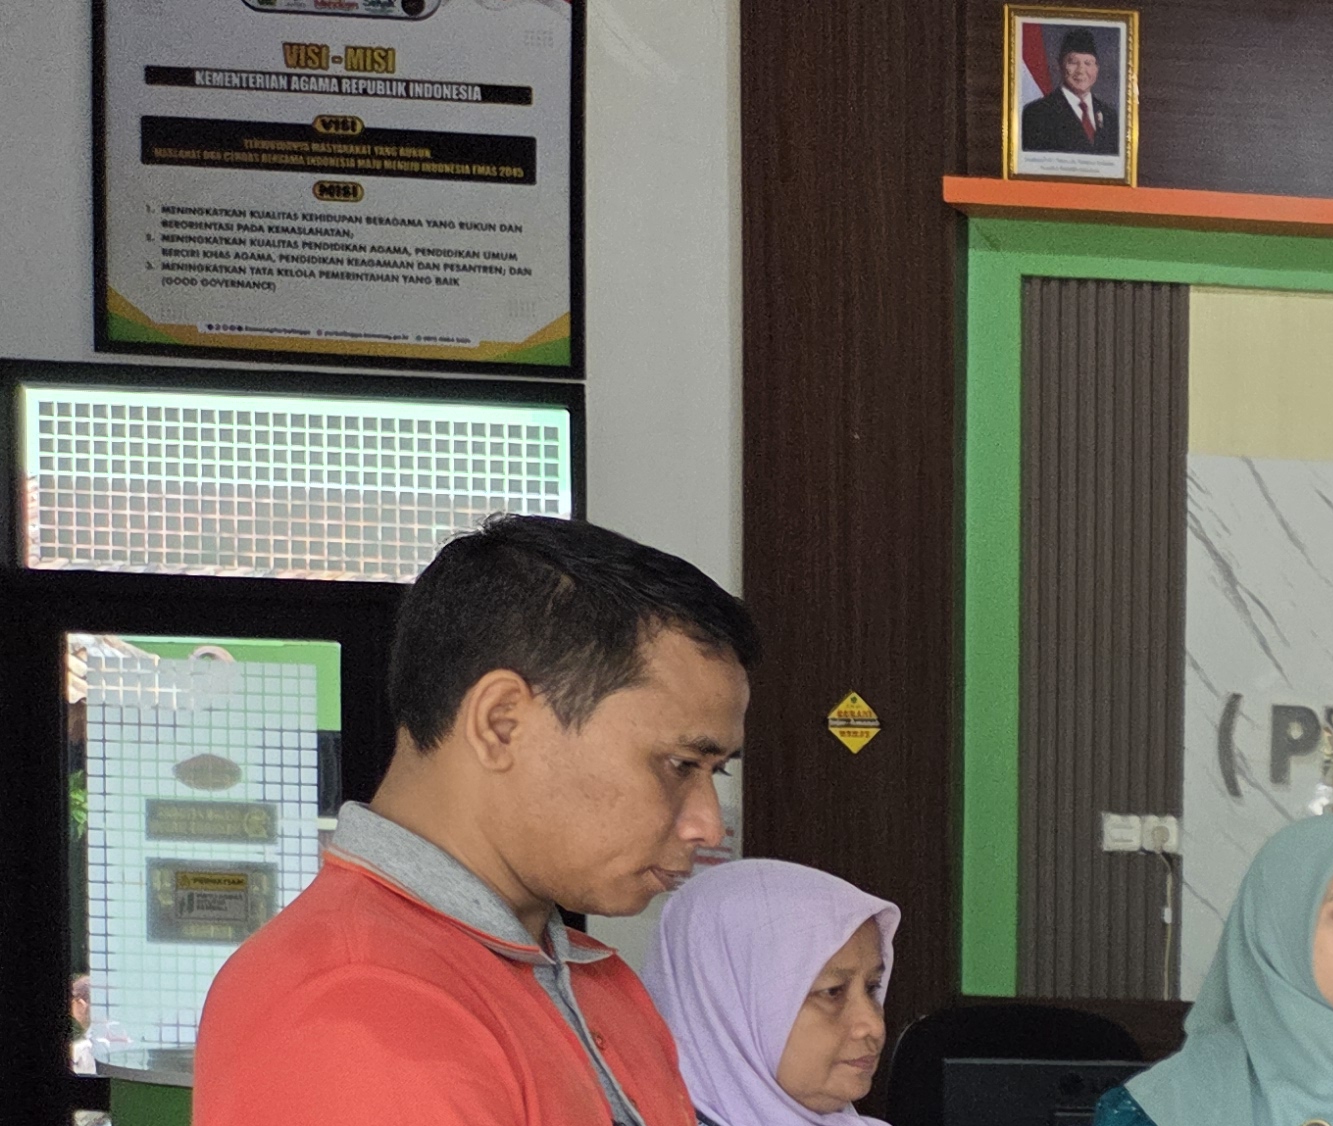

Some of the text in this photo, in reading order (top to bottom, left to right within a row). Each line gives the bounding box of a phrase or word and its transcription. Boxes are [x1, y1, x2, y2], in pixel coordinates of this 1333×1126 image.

[283, 42, 329, 70] VISI
[345, 46, 395, 73] MISI
[195, 71, 482, 100] KEMENTERIAN AGAMA REPUBLIK INDONESIA
[322, 119, 357, 132] VISI
[421, 163, 470, 174] INDONESIA
[161, 206, 246, 217] MENINGKATKAN
[250, 208, 298, 221] KUALITAS
[302, 212, 362, 224] KEHIDUPAN
[366, 216, 423, 227] BERAGAMA
[426, 219, 455, 229] YANG
[459, 221, 496, 232] RUKUN
[500, 224, 522, 233] DAN
[161, 219, 234, 231] BERORIENTASI
[237, 223, 264, 233] PADA
[161, 234, 246, 246] MENINGKATKAN
[250, 238, 298, 249] KUALITAS
[302, 241, 367, 253] PENDIDIKAN
[370, 245, 411, 256] AGAMA,
[415, 248, 479, 259] PENDIDIKAN
[483, 251, 518, 261] UMUM
[161, 263, 246, 274] MENINGKATKAN
[250, 267, 273, 276] TATA
[277, 268, 316, 278] KELOLA
[319, 270, 399, 283] PEMERINTAHAN
[402, 276, 431, 285] YANG
[435, 277, 460, 287] BAIK
[279, 254, 344, 266] PENDIDIKAN
[347, 258, 414, 270] KEAGAMAAN
[417, 262, 440, 271] DAN
[509, 267, 532, 276] DAN
